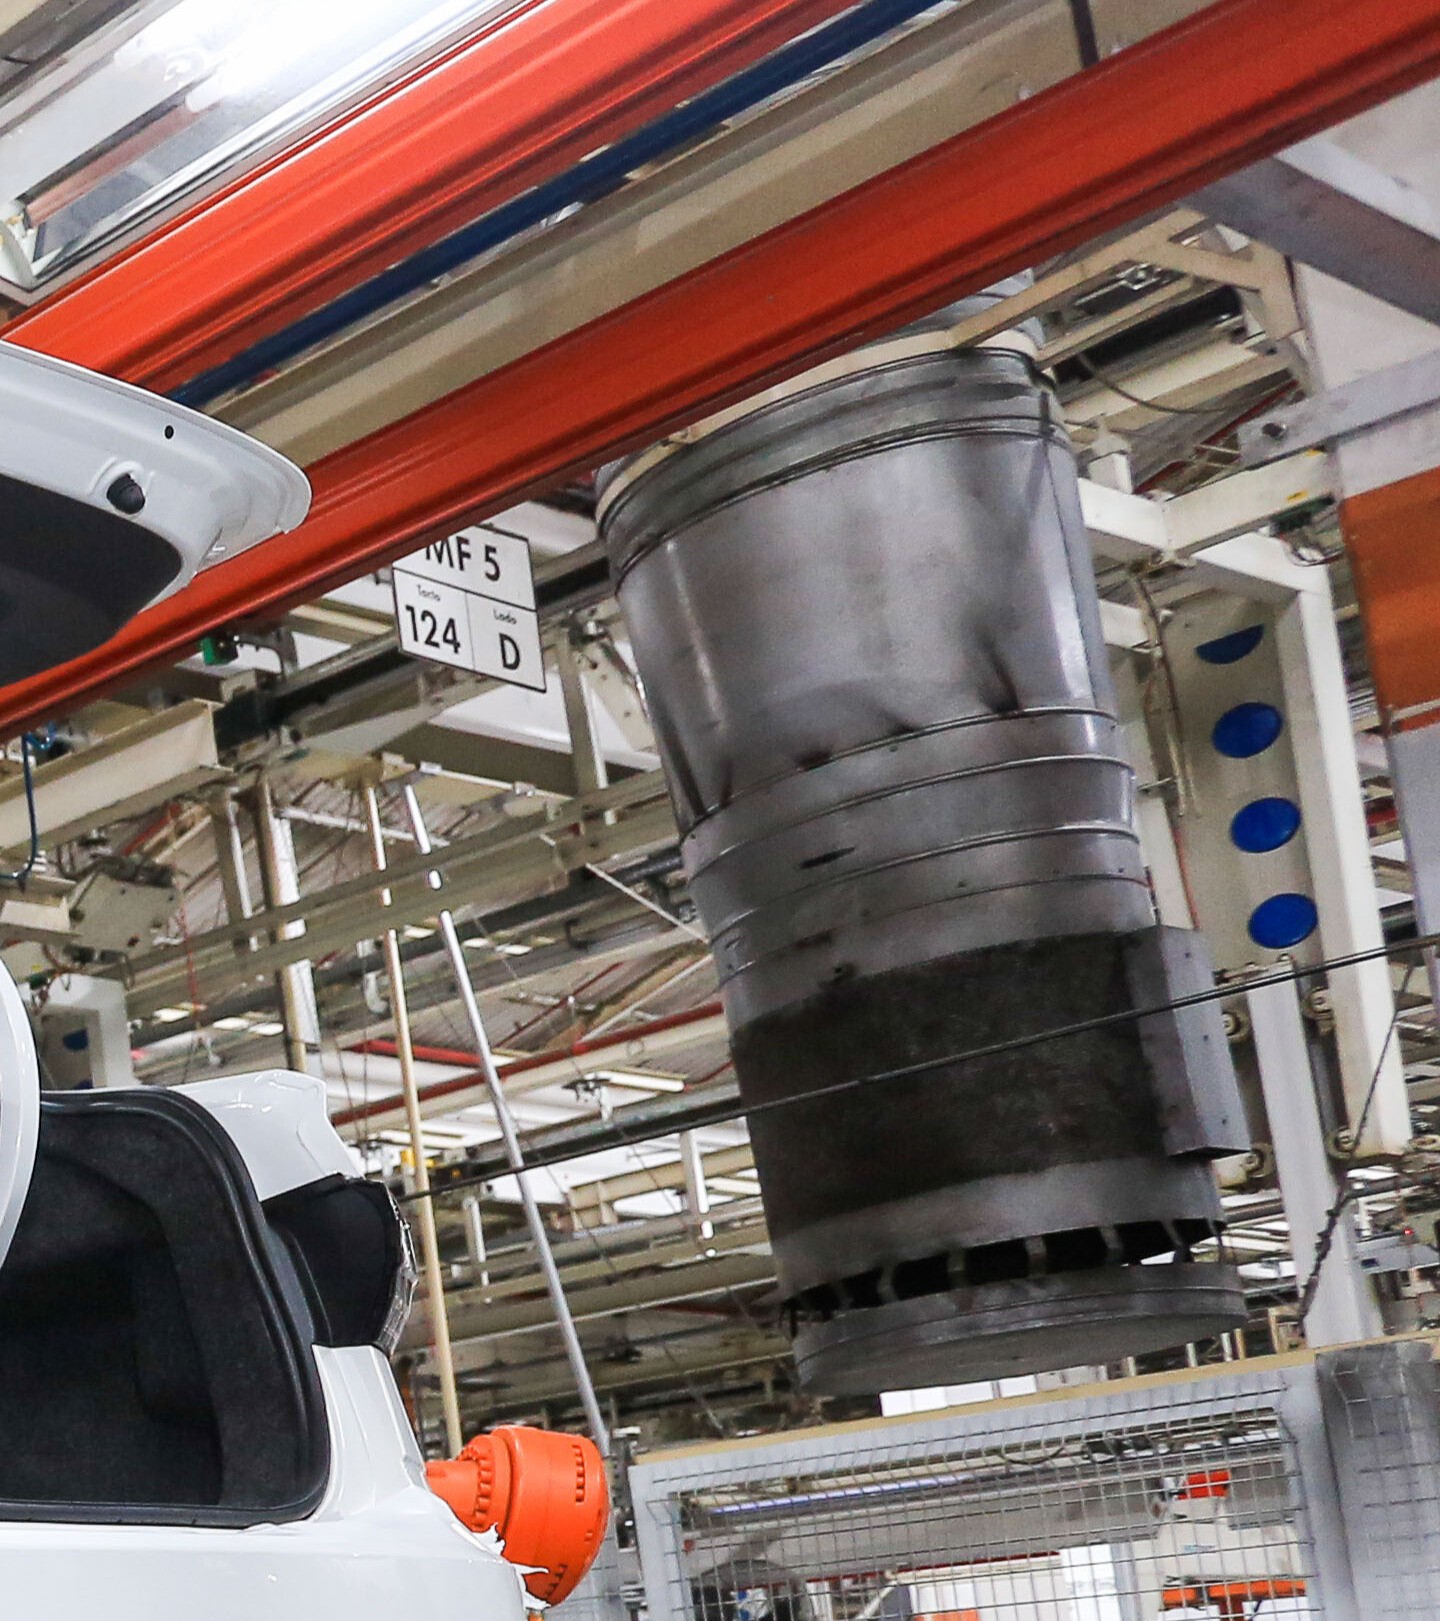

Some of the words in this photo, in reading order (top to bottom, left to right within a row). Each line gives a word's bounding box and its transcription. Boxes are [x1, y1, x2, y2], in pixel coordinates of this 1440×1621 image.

[426, 536, 471, 571] MF
[484, 545, 500, 582] 5
[405, 604, 461, 654] 124
[499, 632, 521, 670] D
